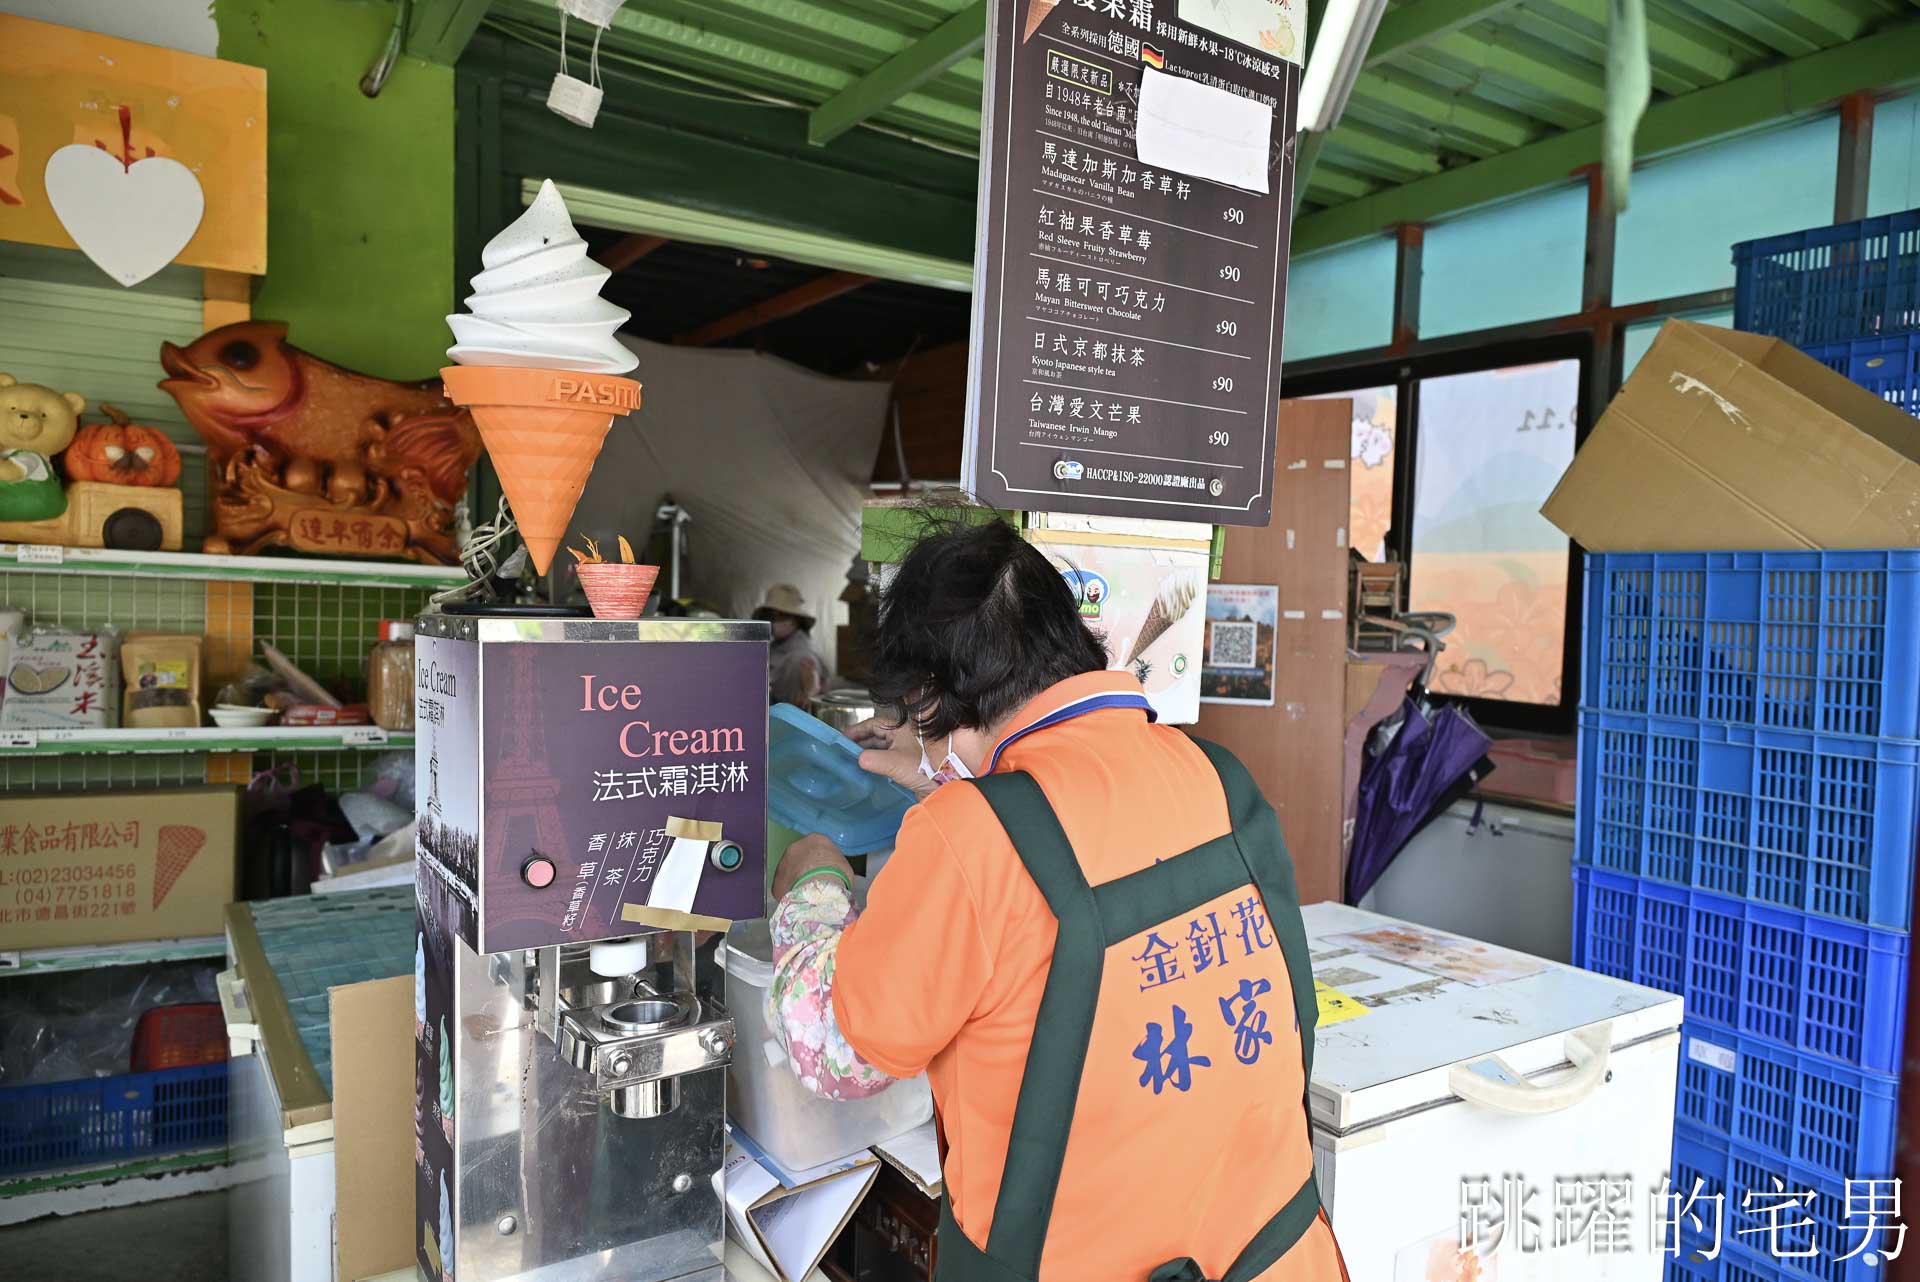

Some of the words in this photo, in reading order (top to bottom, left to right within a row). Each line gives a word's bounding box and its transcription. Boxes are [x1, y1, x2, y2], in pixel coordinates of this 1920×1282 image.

[1062, 22, 1140, 60] 全系列採用德國
[1051, 56, 1108, 88] 嚴選限定新品
[1045, 105, 1062, 117] Since
[1064, 110, 1079, 123] 1948,
[1081, 115, 1090, 126] the
[1091, 119, 1100, 129] old
[1102, 122, 1121, 135] Tainan
[1041, 166, 1085, 185] Madagascar
[1089, 178, 1114, 193] Vanilla
[1117, 186, 1135, 198] Bean
[1042, 141, 1191, 200] 馬達加斯加香草籽
[1038, 205, 1151, 250] 紅袖果香草莓
[1223, 207, 1244, 225] $90
[1038, 230, 1053, 242] Red
[1057, 235, 1080, 248] Sleeve
[1084, 240, 1105, 256] Fruity
[1108, 246, 1147, 264] Strawberry
[1035, 267, 1165, 313] 馬雅可可巧克力
[1219, 265, 1241, 282] $90
[1035, 292, 1060, 306] Mayan
[1064, 298, 1103, 314] Bittersweet
[1107, 306, 1142, 321] Chocolate
[1216, 320, 1237, 337] $90
[1032, 355, 1054, 369] Kyoto
[1055, 360, 1086, 373] Japanese
[1088, 365, 1104, 376] style
[1105, 369, 1116, 377] tea
[1034, 332, 1145, 367] 日式京都抹茶
[1212, 376, 1233, 392] $90
[1030, 392, 1141, 425] 台灣愛文芒果
[1029, 418, 1066, 431] Taiwanese
[1069, 424, 1089, 434] Irwin
[1093, 427, 1118, 439] Mango
[1208, 430, 1229, 447] $90
[418, 658, 429, 690] Ice
[430, 660, 457, 698] Cream
[580, 675, 642, 712] Ice
[619, 720, 746, 758] Cream
[592, 761, 749, 802] 法式霜淇淋
[603, 831, 638, 886] 抹茶
[632, 828, 667, 883] 巧克力
[16, 881, 136, 904] (04)7751818
[1132, 896, 1274, 993] 金針花
[1132, 978, 1298, 1096] 林家
